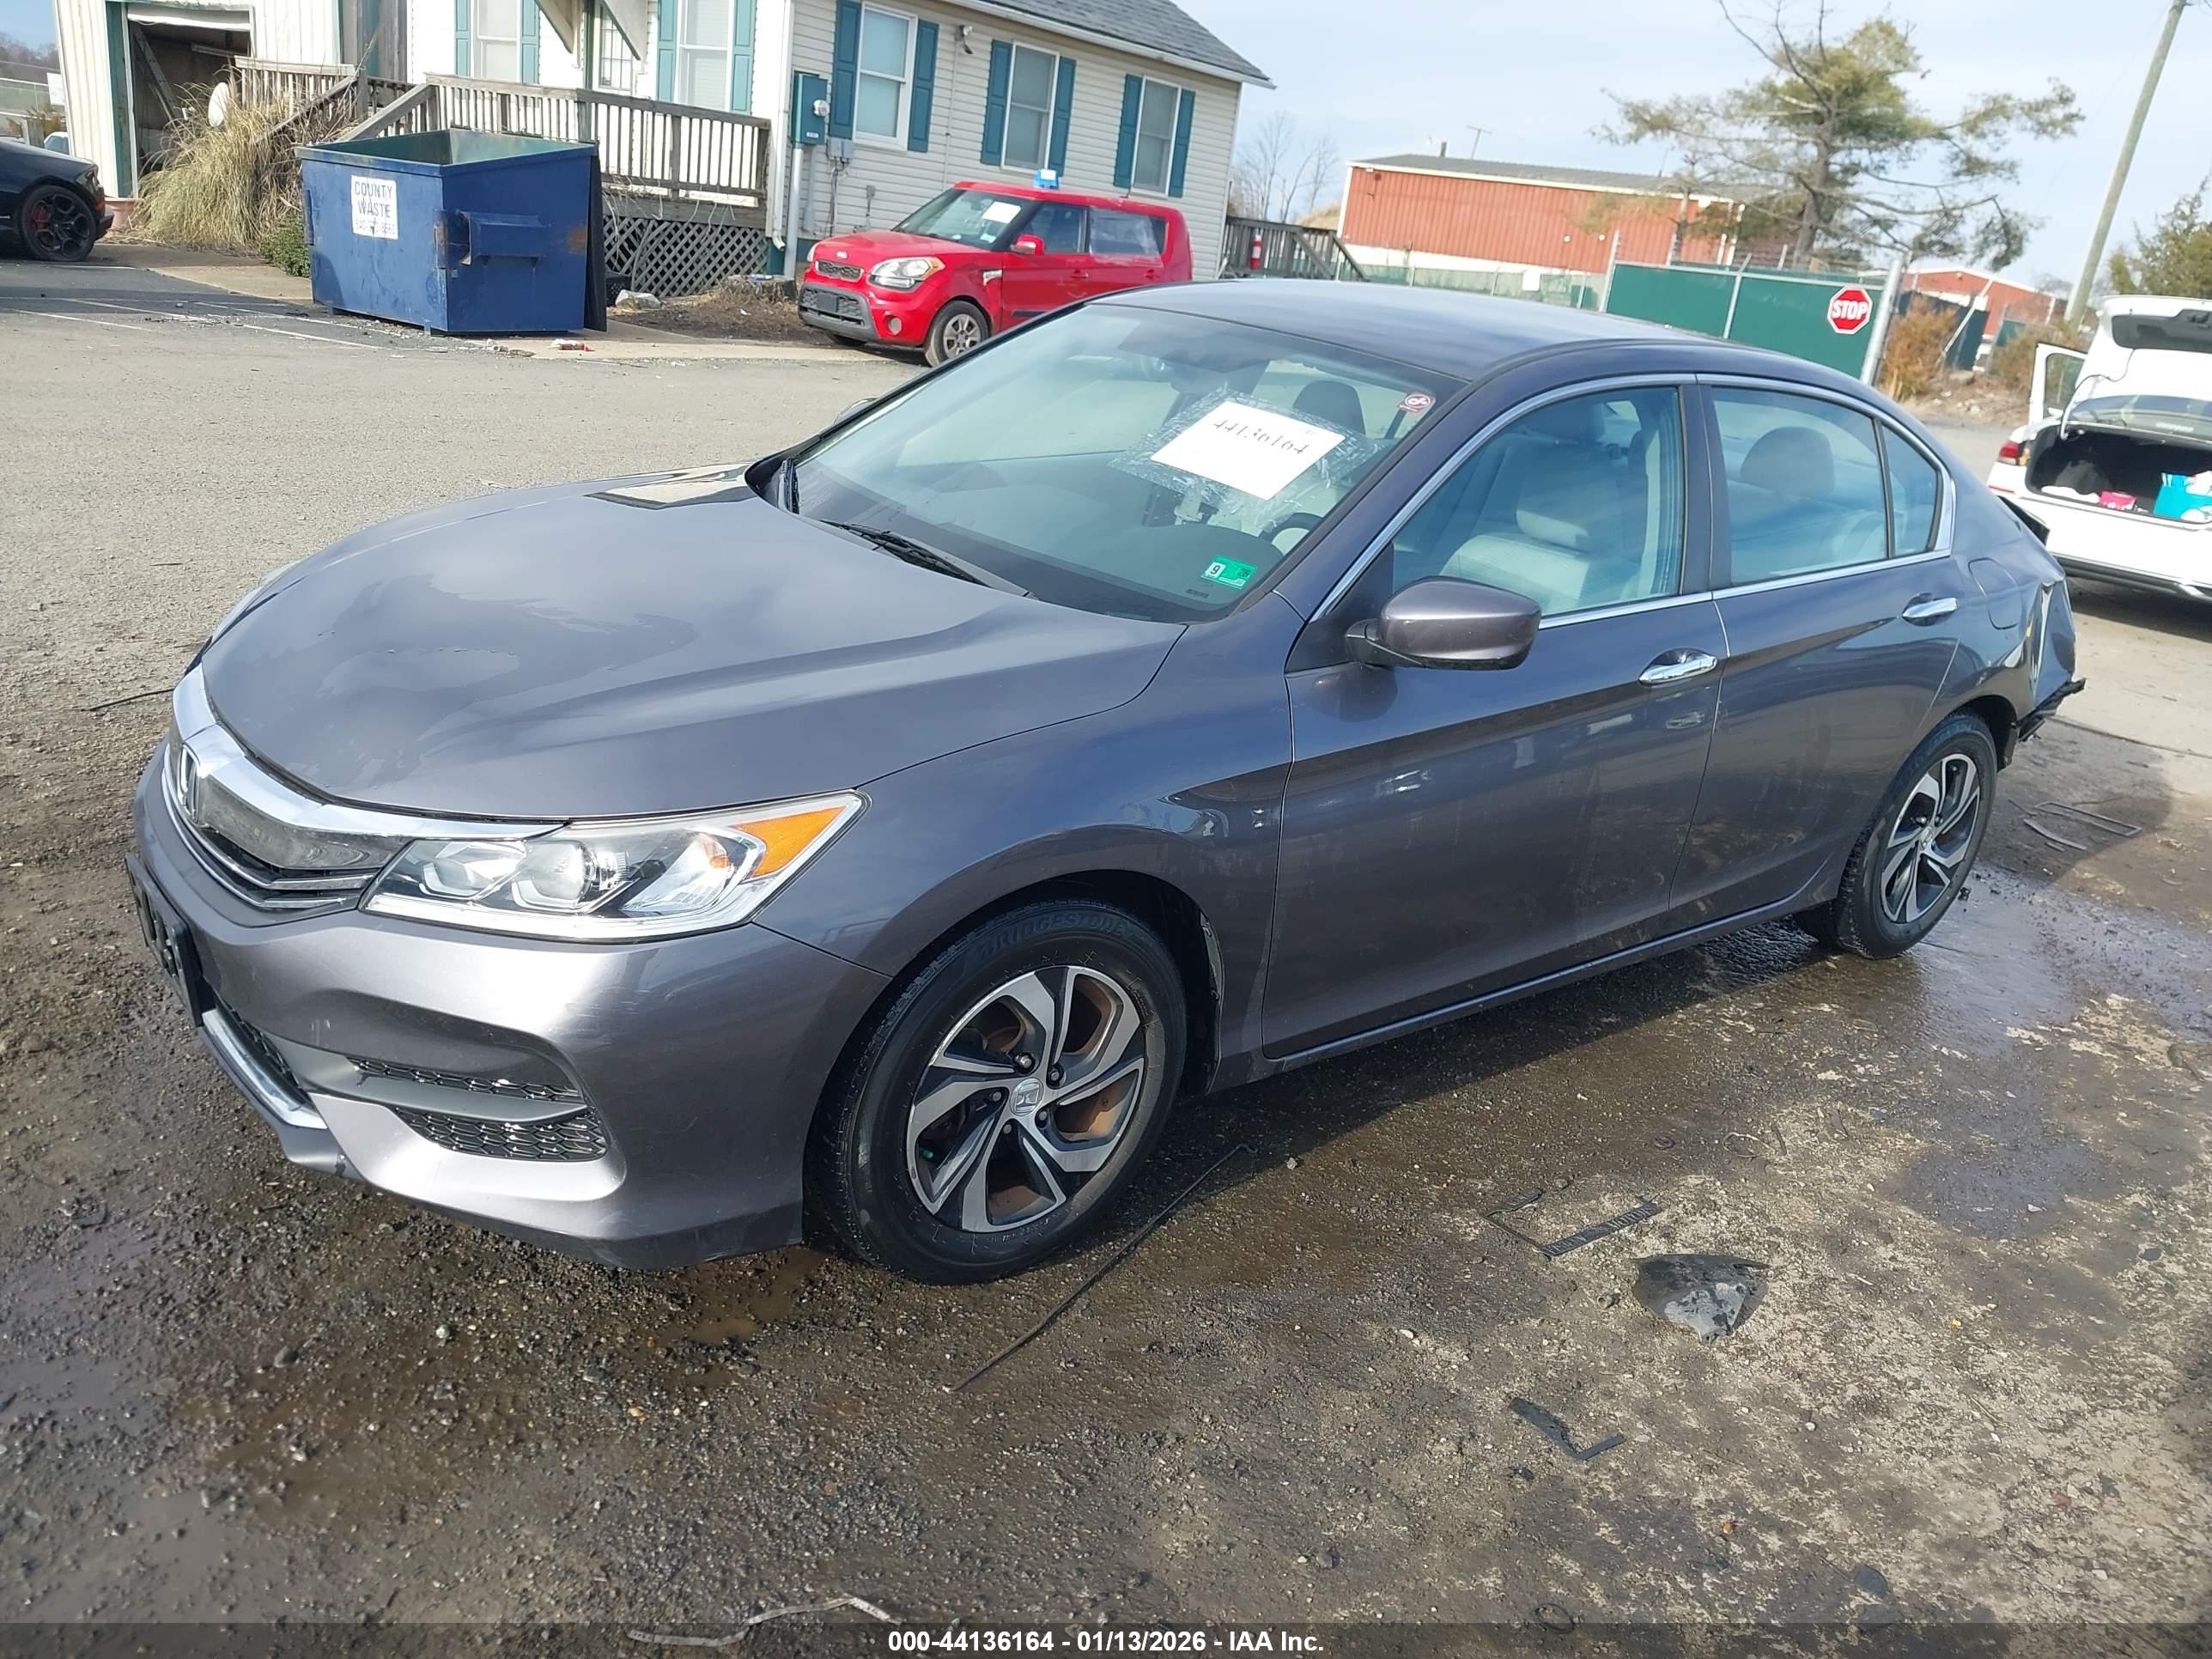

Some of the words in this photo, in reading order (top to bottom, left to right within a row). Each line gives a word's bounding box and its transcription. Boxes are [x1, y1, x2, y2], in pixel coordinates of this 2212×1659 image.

[355, 181, 392, 199] COUNTY
[357, 200, 391, 218] WASTE
[1832, 299, 1869, 320] STOP
[1210, 564, 1221, 575] 9
